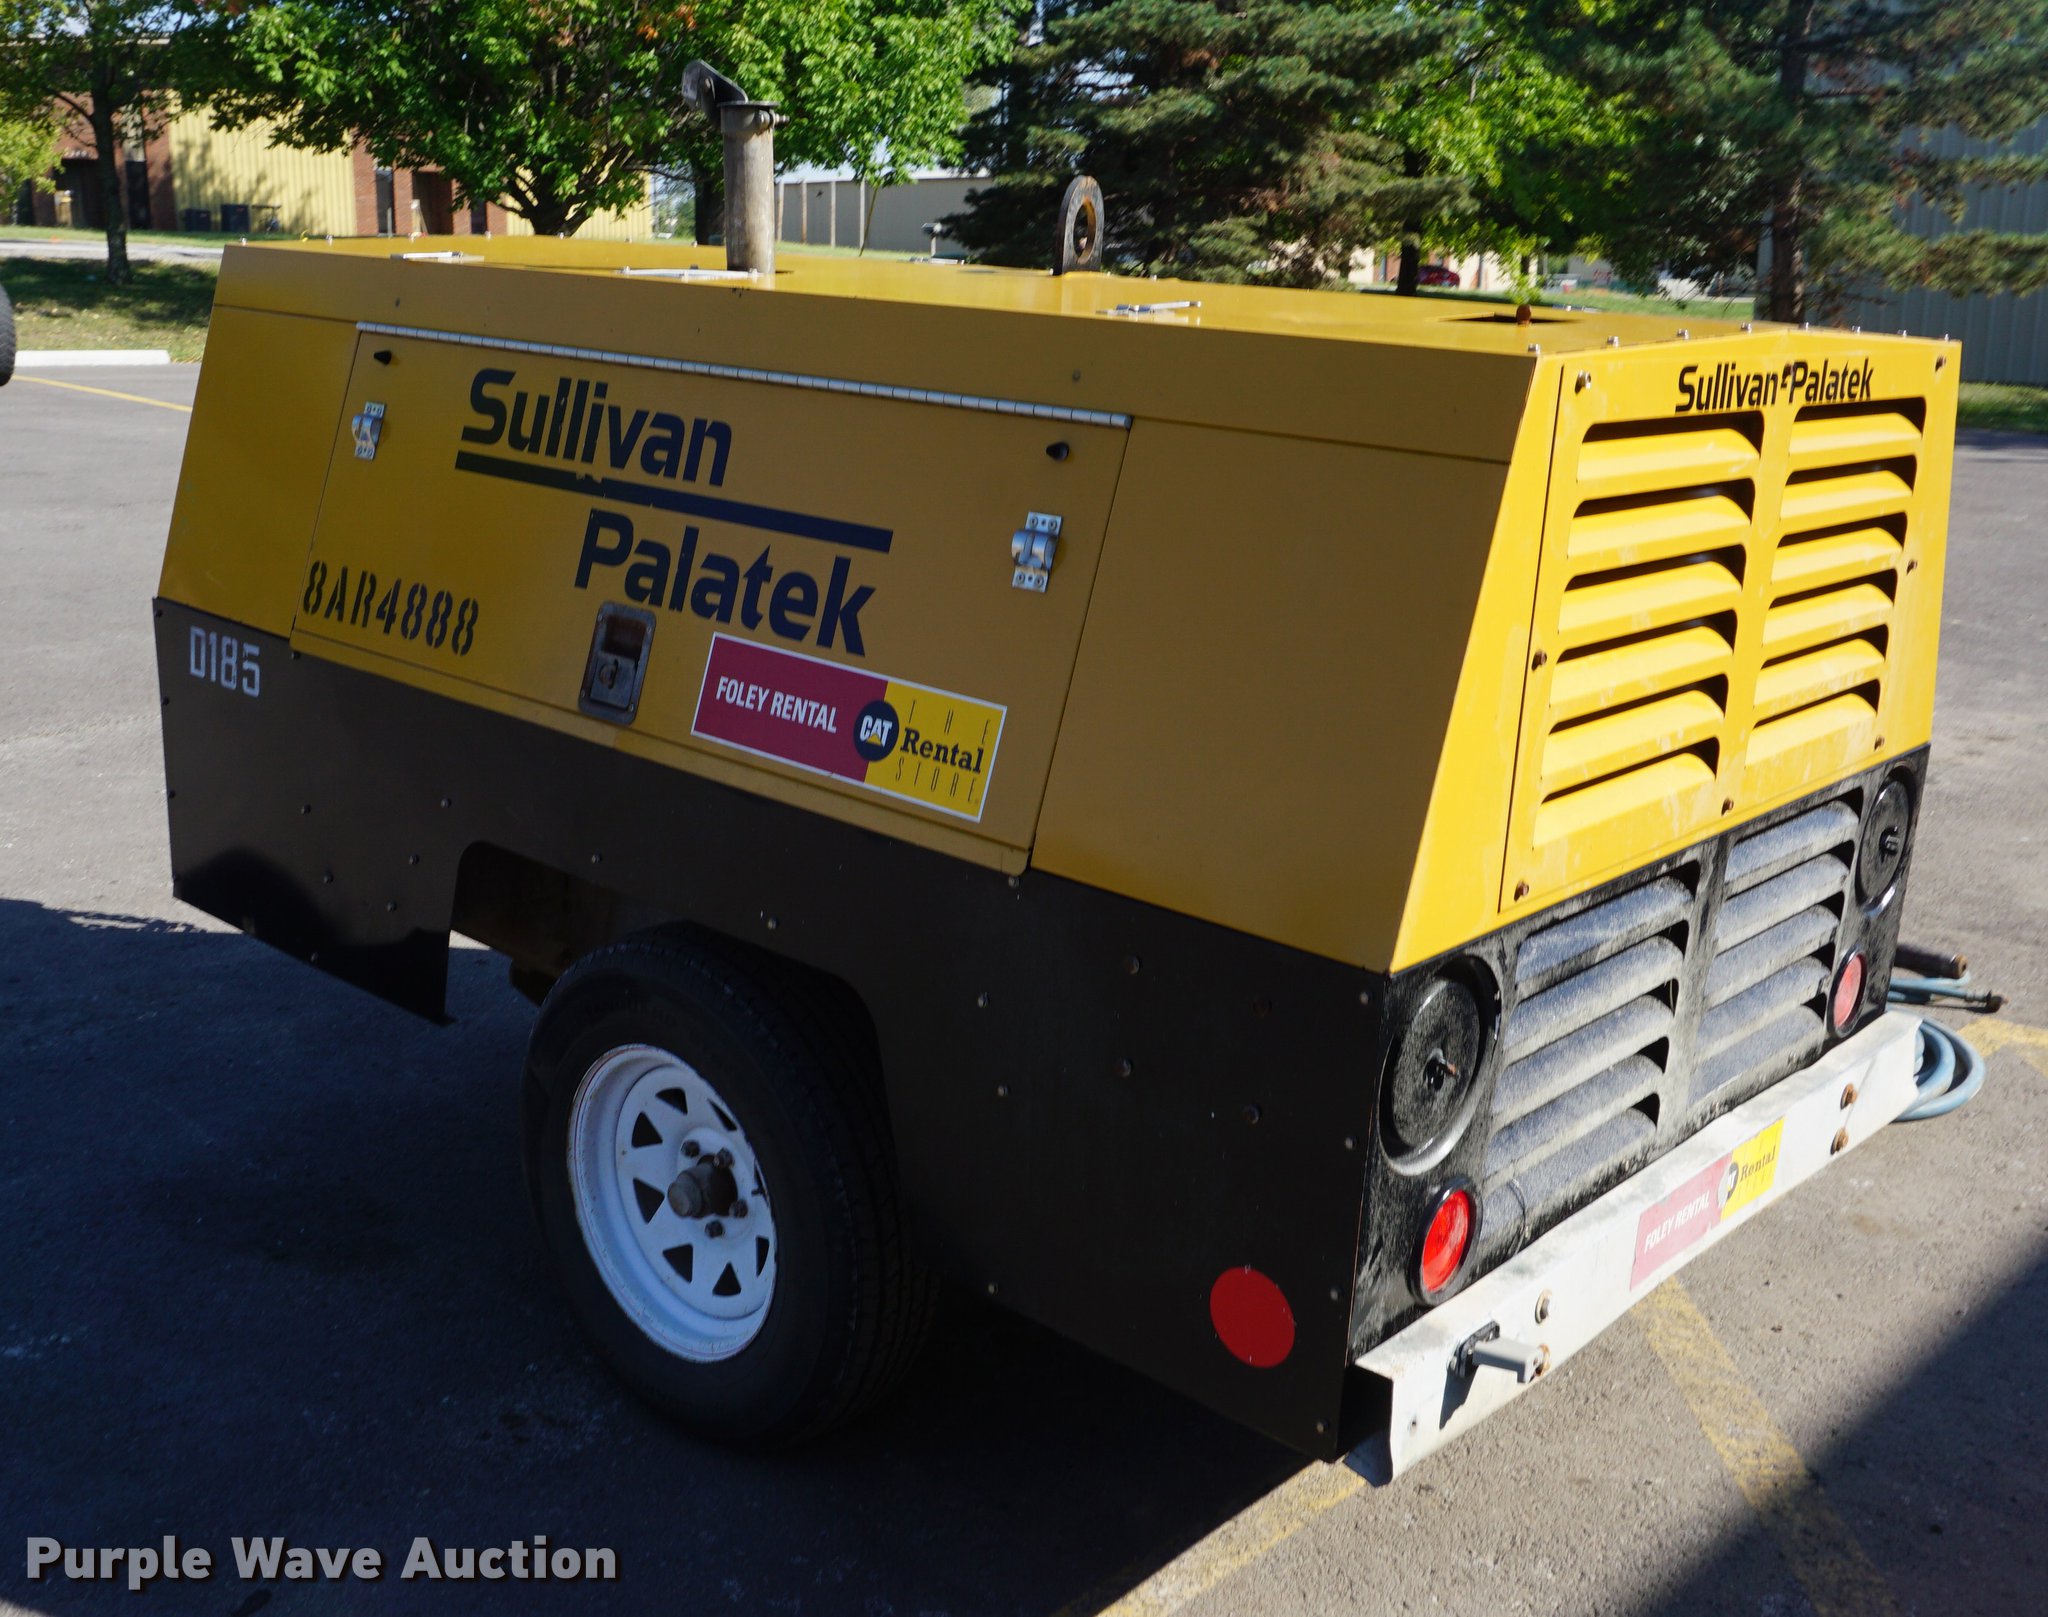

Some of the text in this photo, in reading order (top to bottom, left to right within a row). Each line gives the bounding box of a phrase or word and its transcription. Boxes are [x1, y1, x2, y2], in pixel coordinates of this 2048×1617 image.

[1675, 357, 1874, 413] Sullivan Palatek
[461, 368, 732, 487] Sullivan
[303, 560, 479, 656] 8AR4888
[574, 508, 876, 657] Palatek
[189, 624, 260, 697] D185
[716, 676, 837, 733] FOLEY RENTAL
[859, 714, 893, 747] CAT
[900, 727, 984, 774] Rental
[1740, 1144, 1776, 1182] Rental
[1644, 1191, 1711, 1255] FOLEY RENTAL
